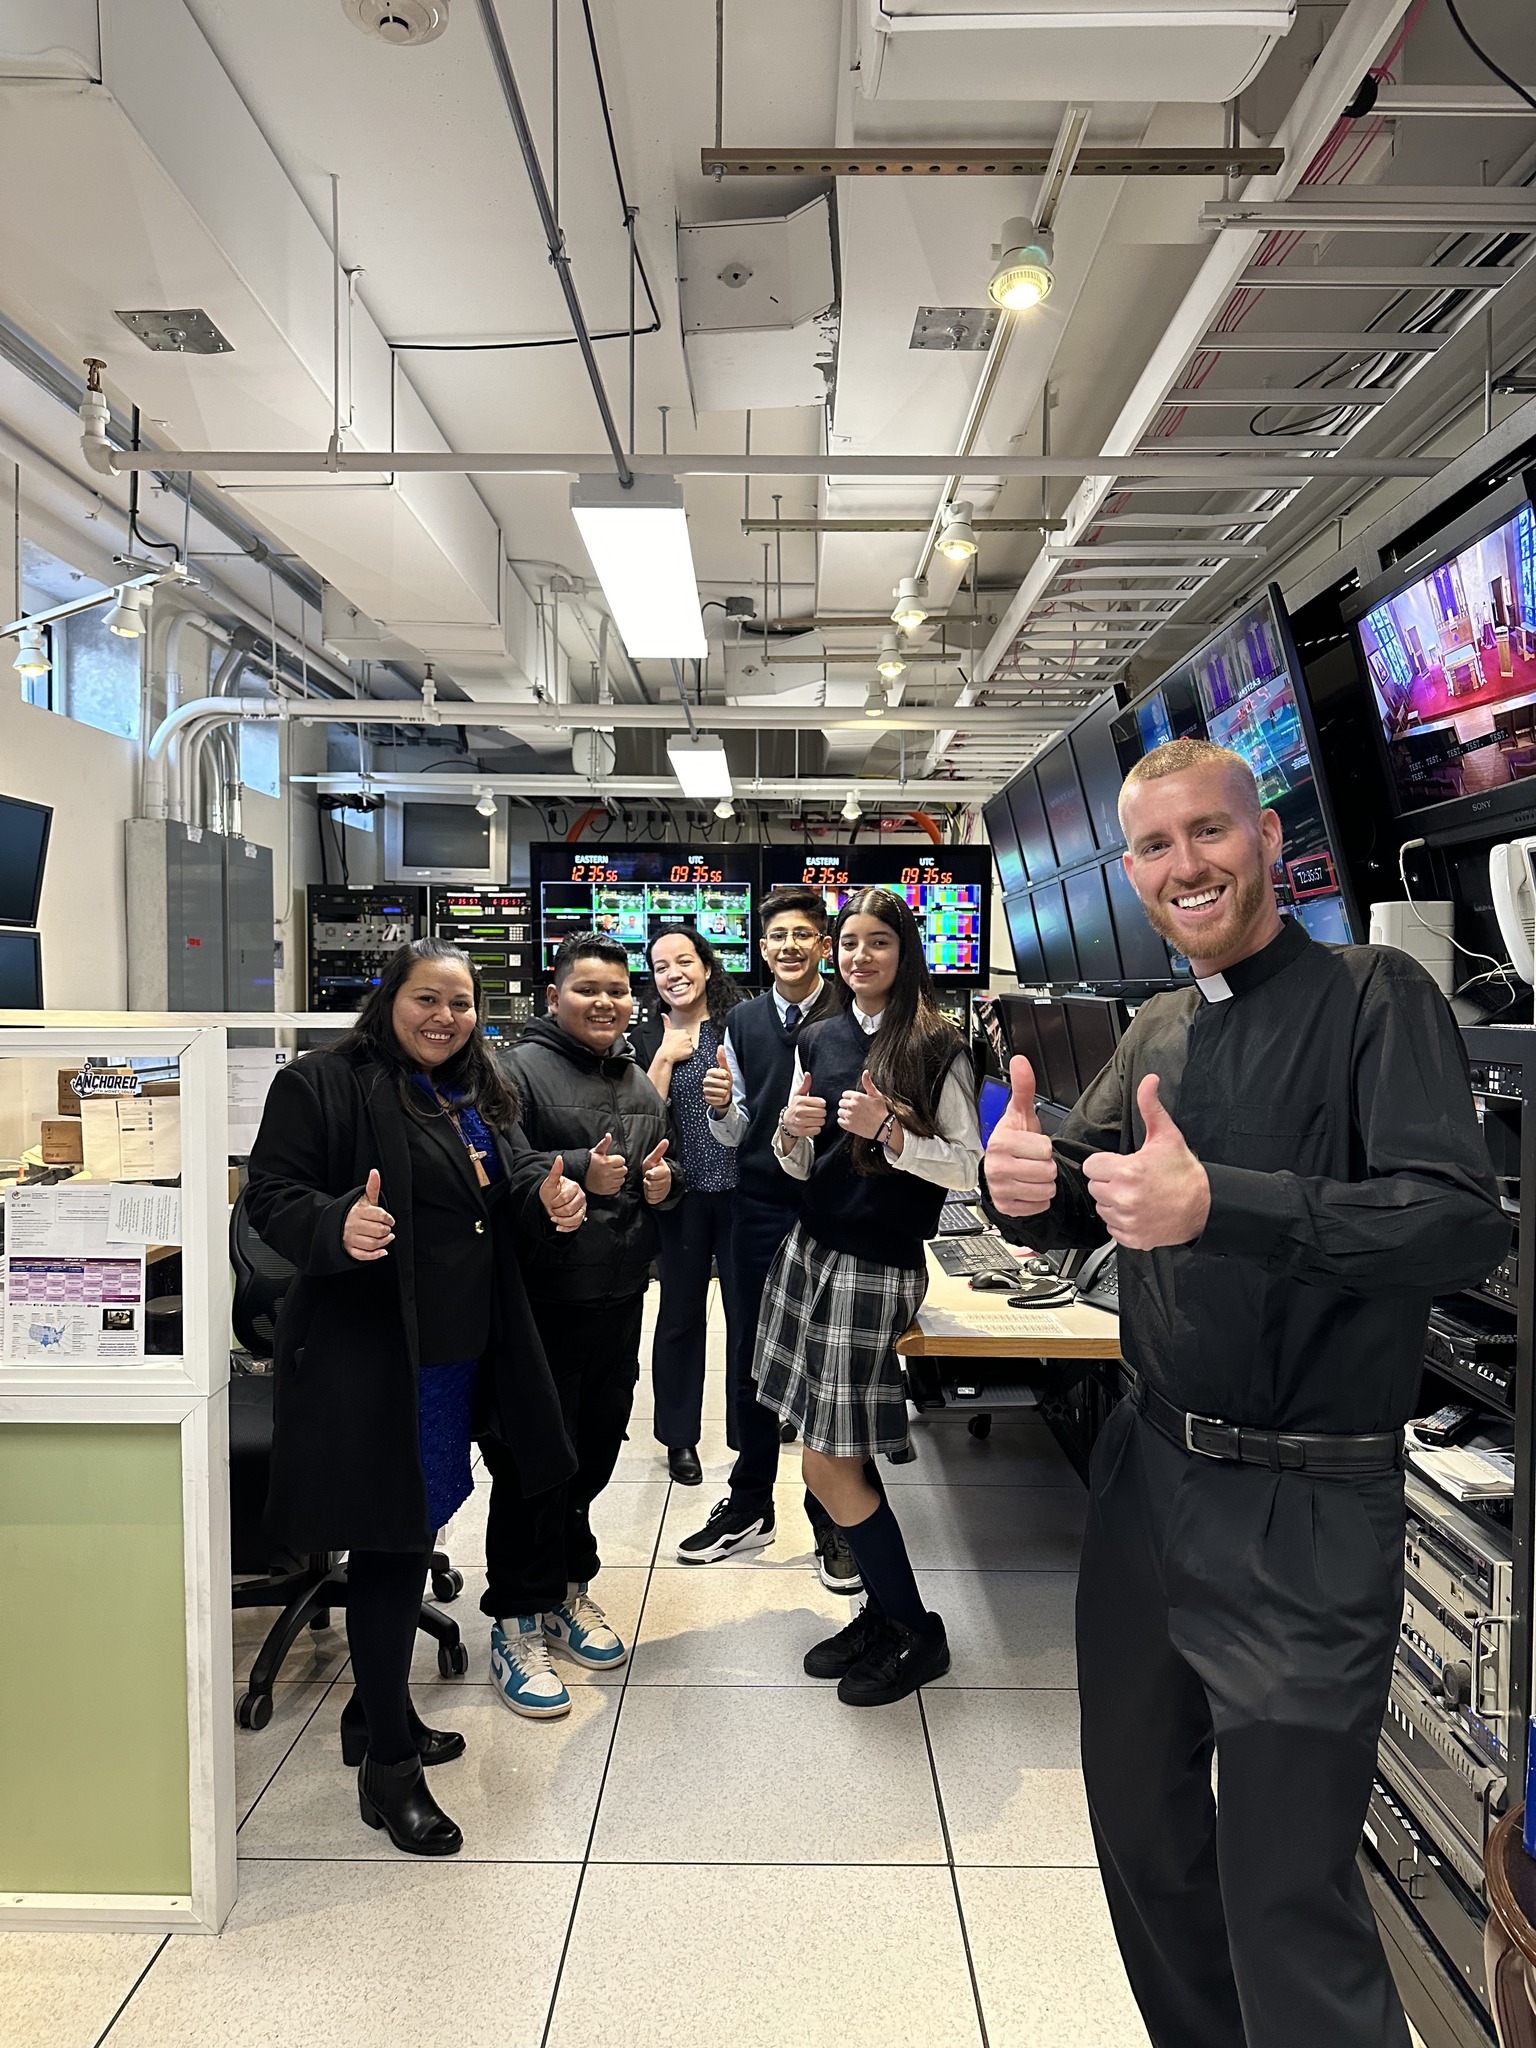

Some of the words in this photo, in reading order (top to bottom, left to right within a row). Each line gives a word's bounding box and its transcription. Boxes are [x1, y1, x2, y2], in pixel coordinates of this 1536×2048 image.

[1409, 761, 1425, 772] TEST.
[1425, 754, 1442, 766] TEST.
[1446, 747, 1464, 758] TEST.
[1465, 740, 1484, 752] TEST.
[1489, 730, 1509, 743] TEST.
[1411, 772, 1427, 782] TEST.
[1472, 800, 1492, 812] SONY
[575, 855, 609, 864] EASTERN
[688, 855, 704, 864] UTC
[806, 857, 840, 866] EASTERN
[919, 857, 935, 866] UTC
[1297, 867, 1323, 884] 12:35:57
[75, 1075, 138, 1089] ANCHORED
